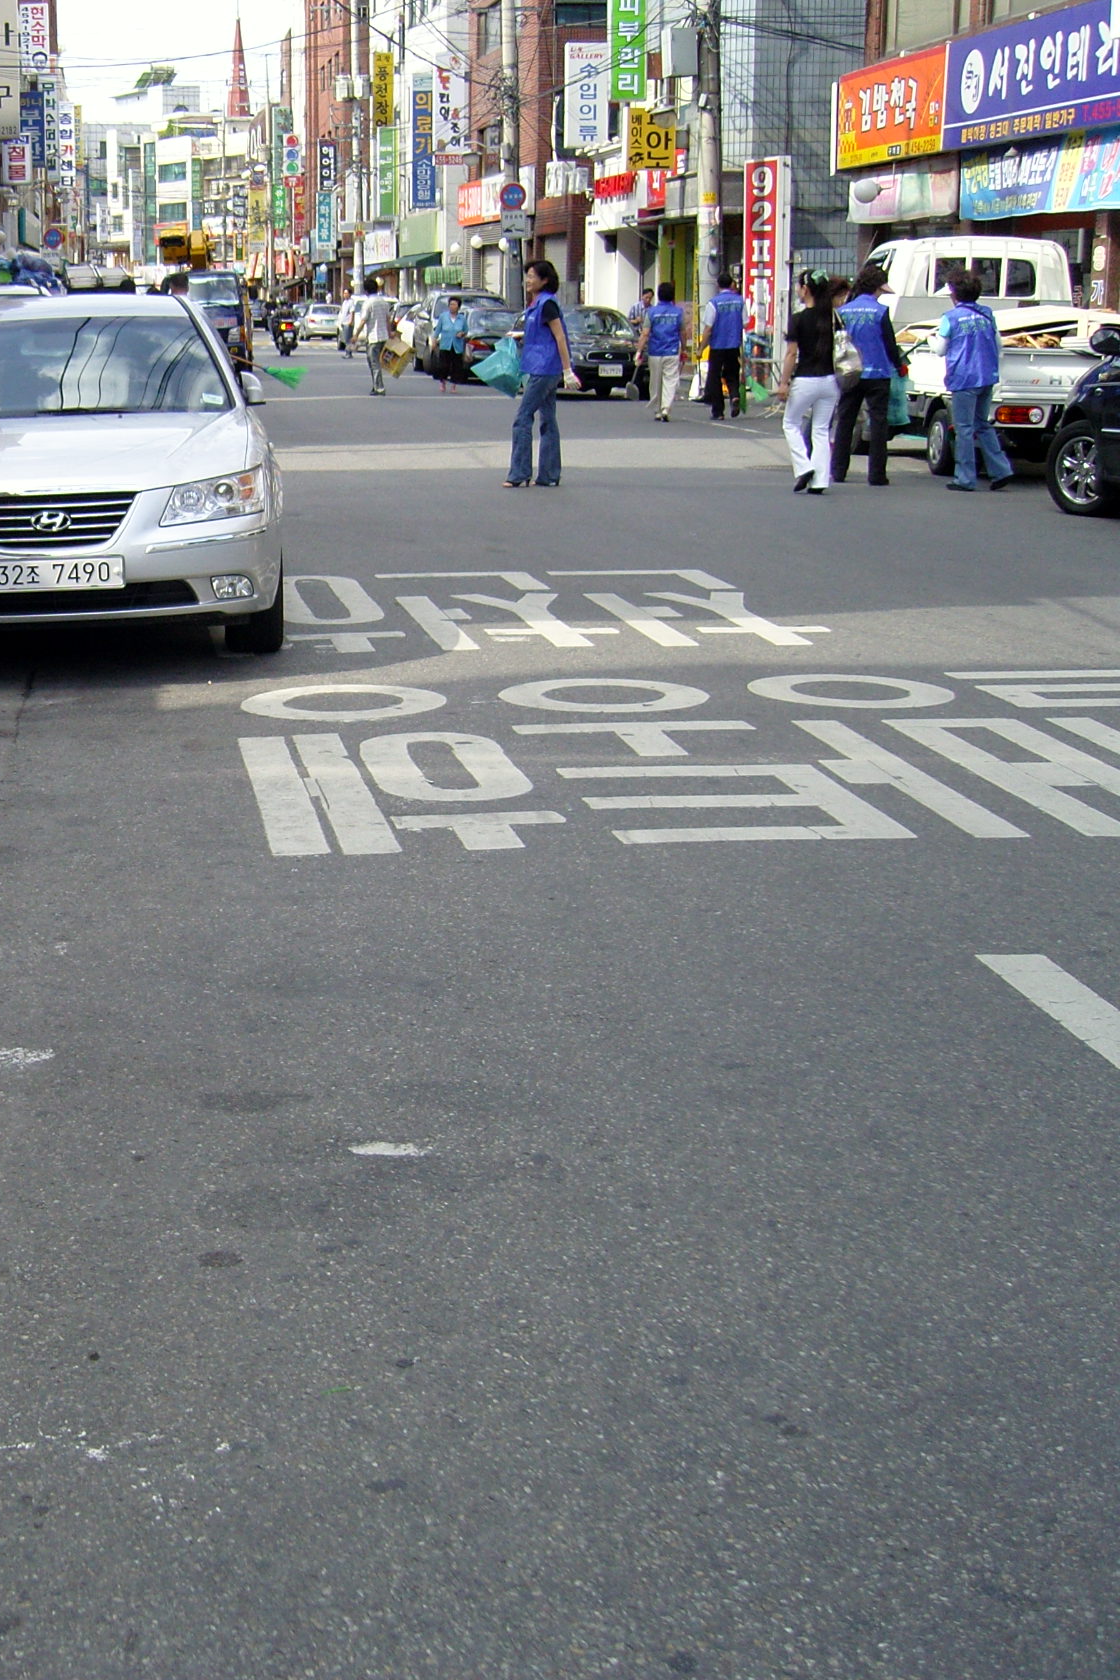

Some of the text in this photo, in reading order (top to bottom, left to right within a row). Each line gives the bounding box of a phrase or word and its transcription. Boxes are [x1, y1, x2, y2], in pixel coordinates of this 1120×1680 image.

[30, 6, 46, 48] 현수막
[579, 63, 599, 142] 수입의류
[859, 75, 917, 132] 김밥천국
[631, 114, 644, 149] 베이스
[645, 113, 672, 169] 아노
[52, 562, 110, 585] 7490
